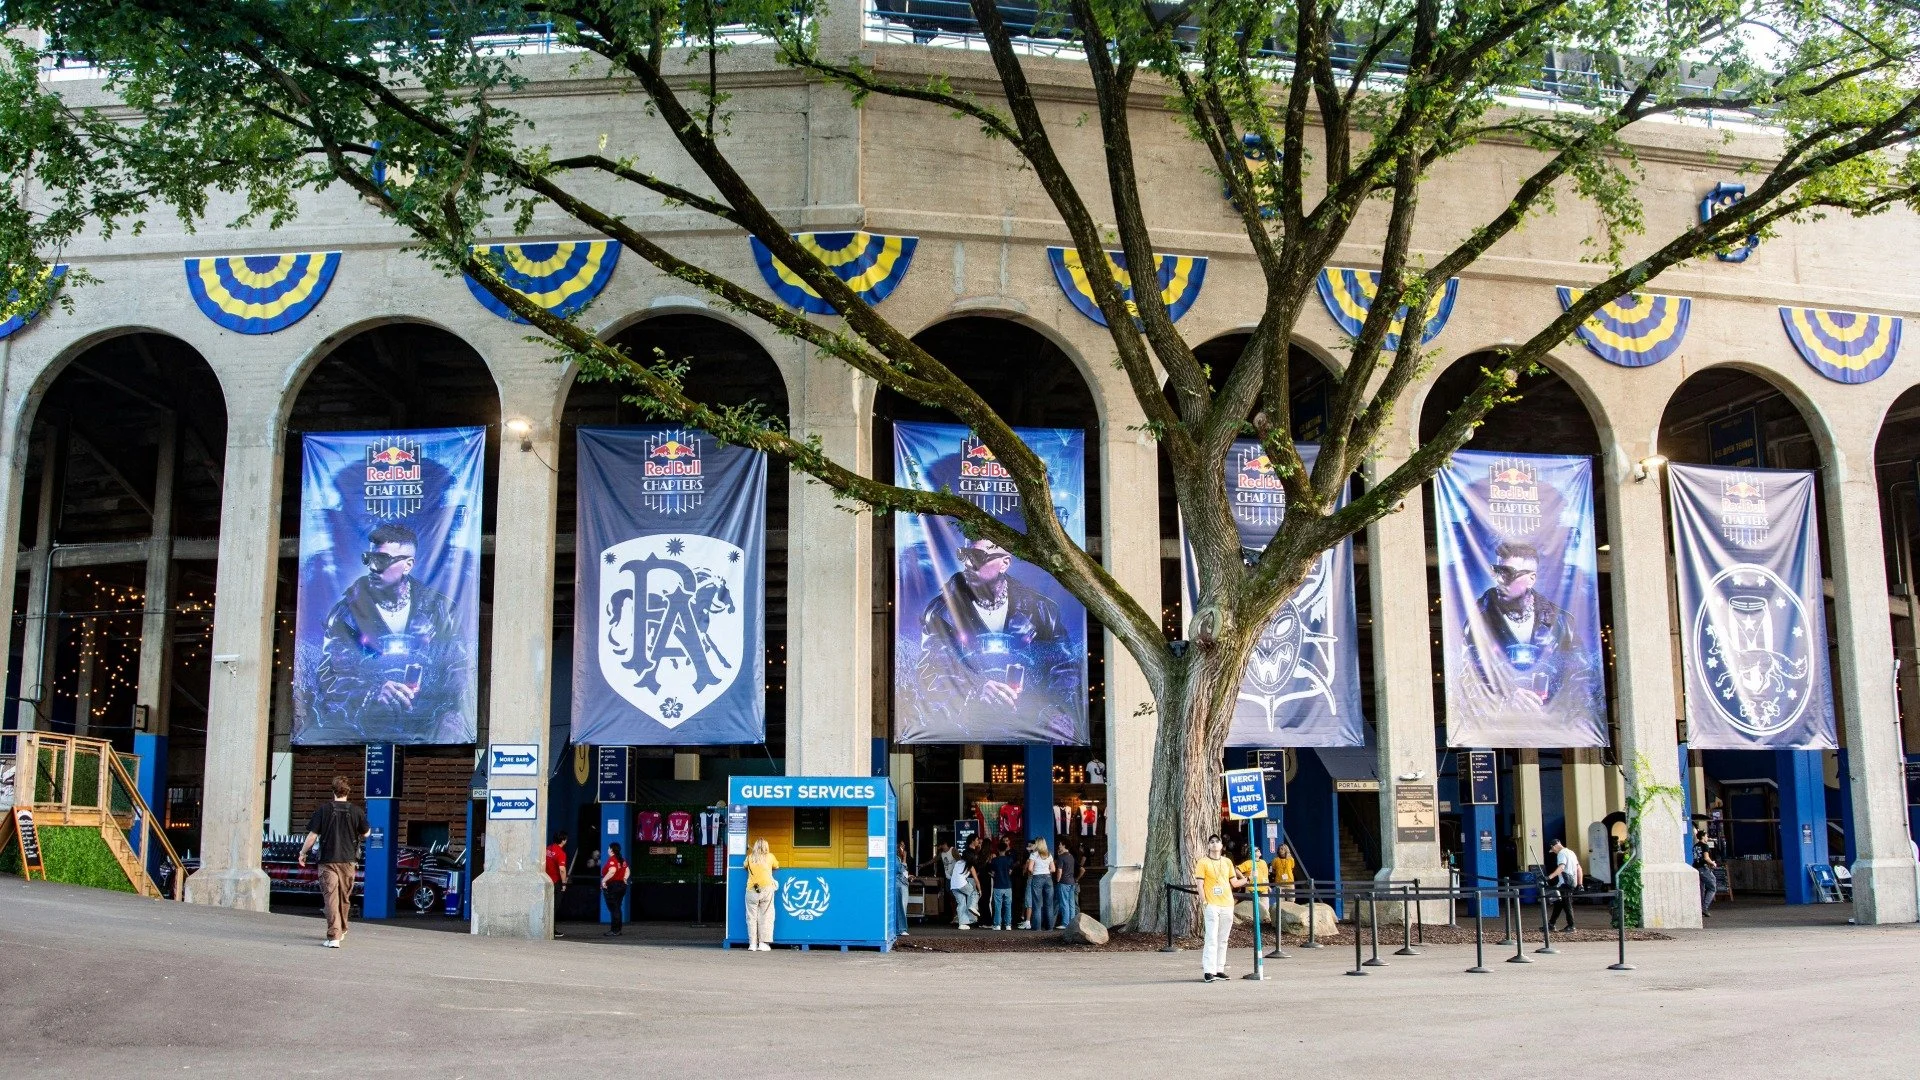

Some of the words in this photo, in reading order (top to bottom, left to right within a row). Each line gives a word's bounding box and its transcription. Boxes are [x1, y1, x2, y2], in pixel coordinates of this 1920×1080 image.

[367, 466, 394, 481] Red
[395, 465, 420, 480] Bull
[645, 461, 673, 476] Red
[674, 460, 700, 476] Bull
[962, 461, 990, 476] Red
[991, 462, 1011, 478] Bu
[643, 480, 703, 491] CHAPTERS
[1238, 474, 1264, 488] Red
[1265, 476, 1284, 490] Bu
[365, 484, 422, 496] CHAPTERS
[1490, 485, 1514, 500] Red
[1515, 486, 1538, 500] Bull
[1236, 492, 1286, 504] CHAPTER
[1489, 502, 1540, 514] CHAPTERS
[1722, 515, 1769, 526] CHAPTERS
[992, 764, 1084, 784] MECH
[1230, 774, 1258, 784] MERCH
[741, 785, 792, 799] GUEST
[798, 785, 875, 799] SERVICES
[1232, 794, 1262, 803] STARTS
[1238, 804, 1258, 812] HERE
